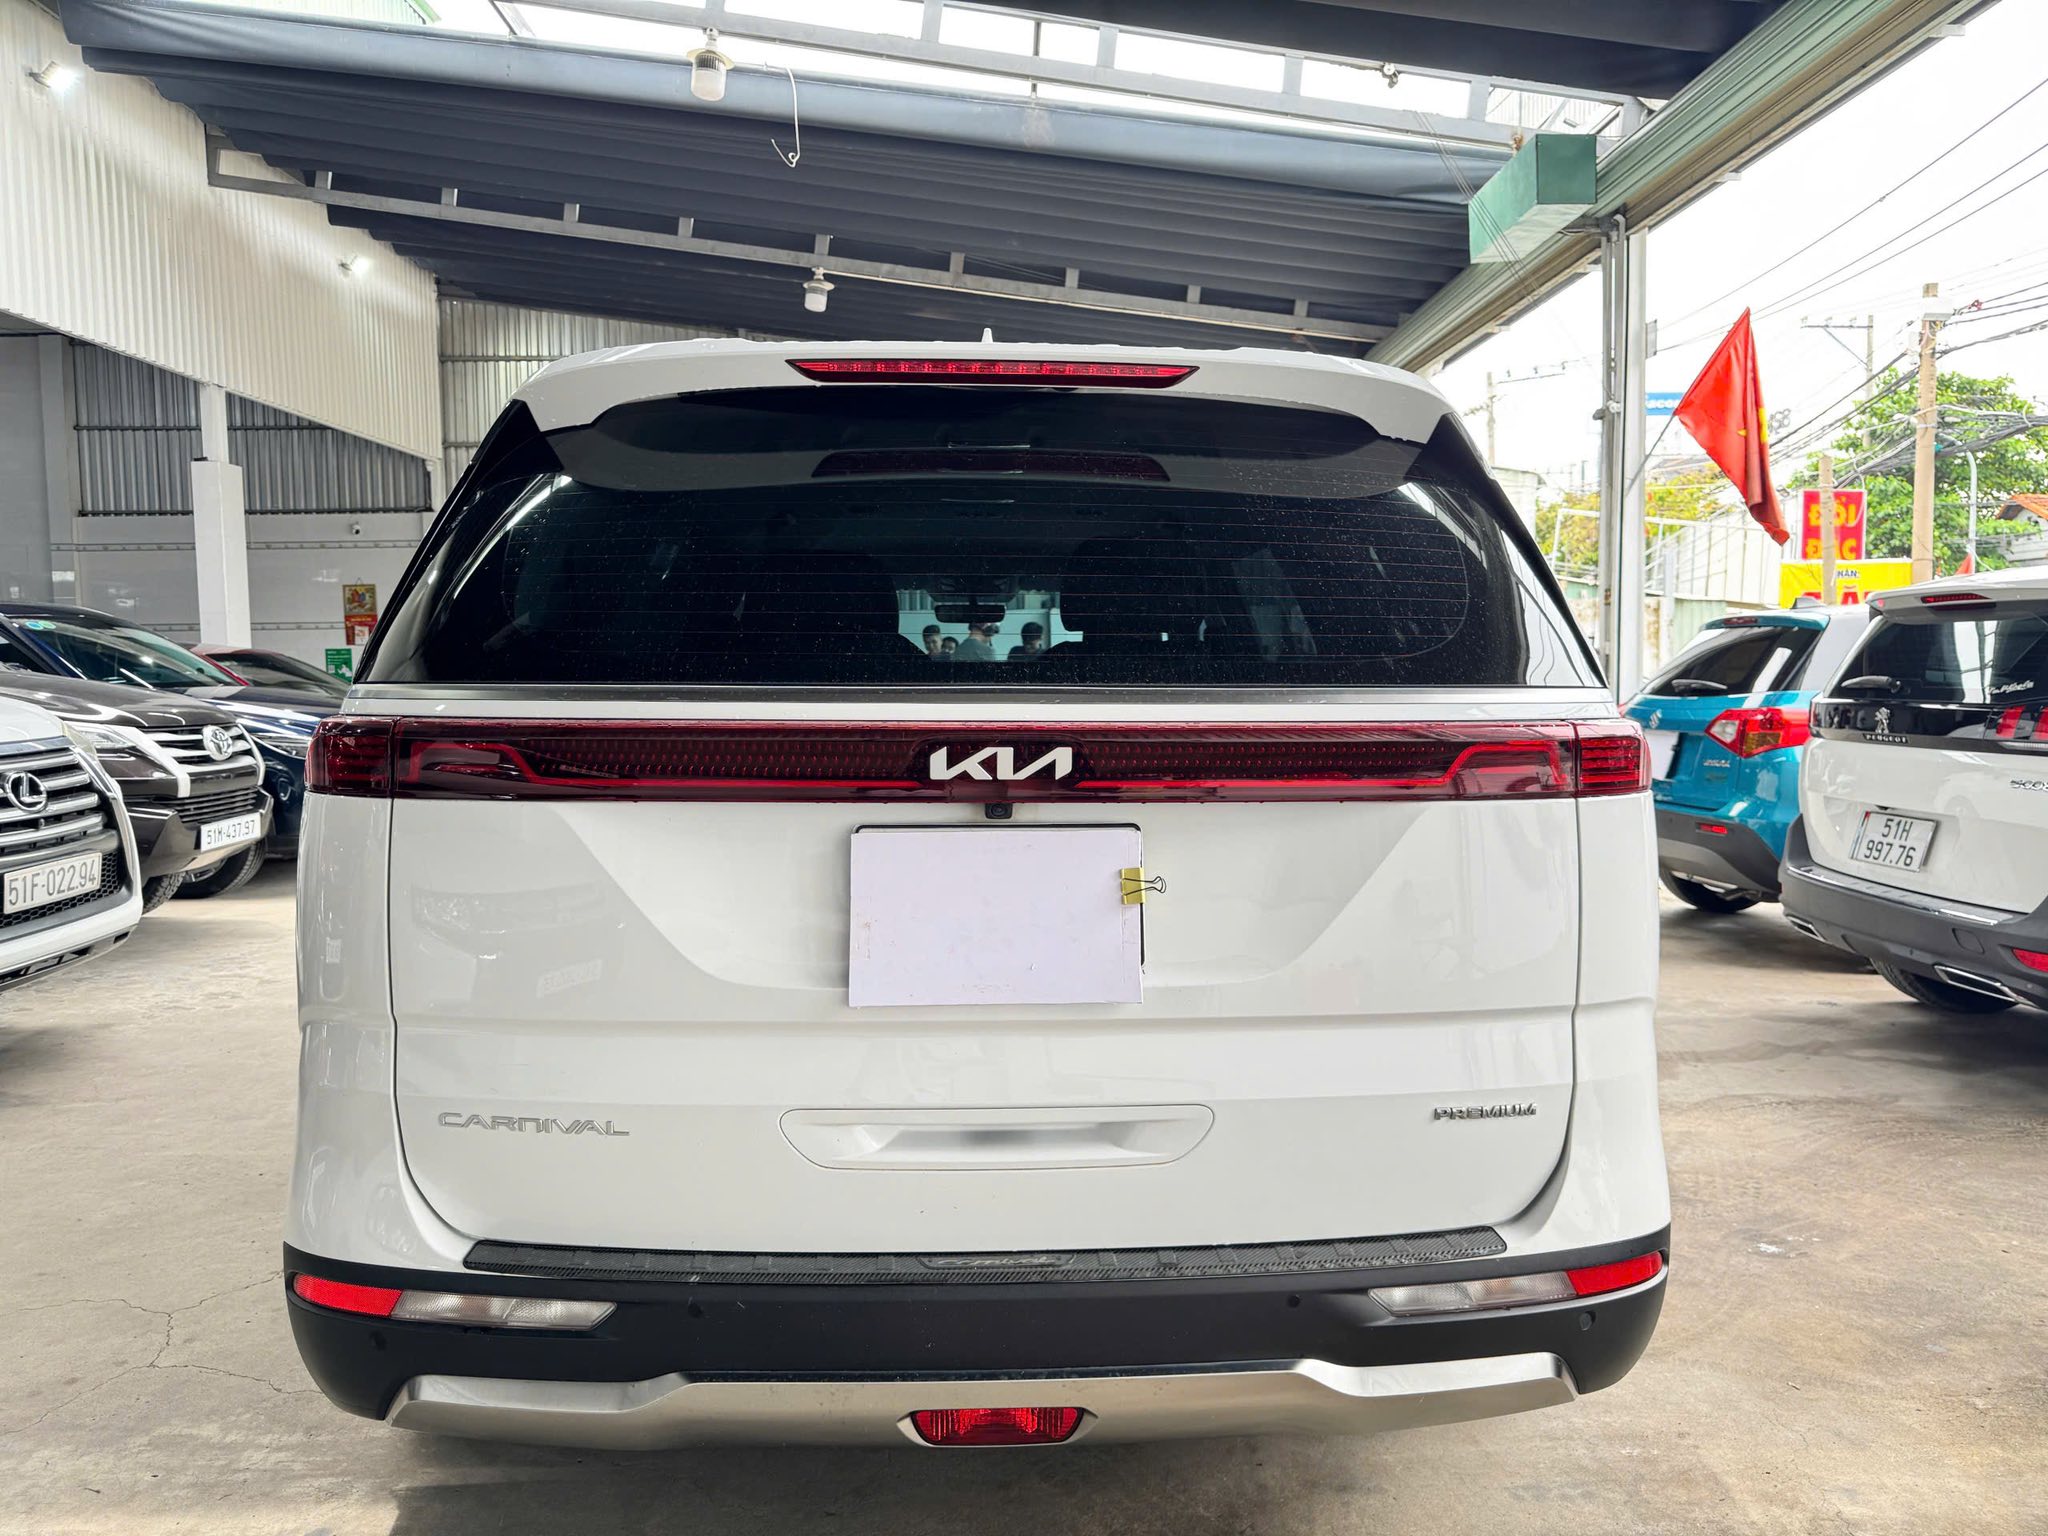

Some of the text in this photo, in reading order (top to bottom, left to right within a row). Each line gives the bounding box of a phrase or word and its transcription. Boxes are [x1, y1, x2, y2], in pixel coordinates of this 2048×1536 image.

[1866, 733, 1908, 744] PEUGEOT
[930, 746, 1073, 780] KIA
[1881, 818, 1914, 842] 51H
[1864, 840, 1917, 867] 997.76
[8, 859, 97, 906] 51F-022.94
[1433, 1102, 1537, 1120] PREMIUM
[438, 1112, 630, 1137] CARNIVAL
